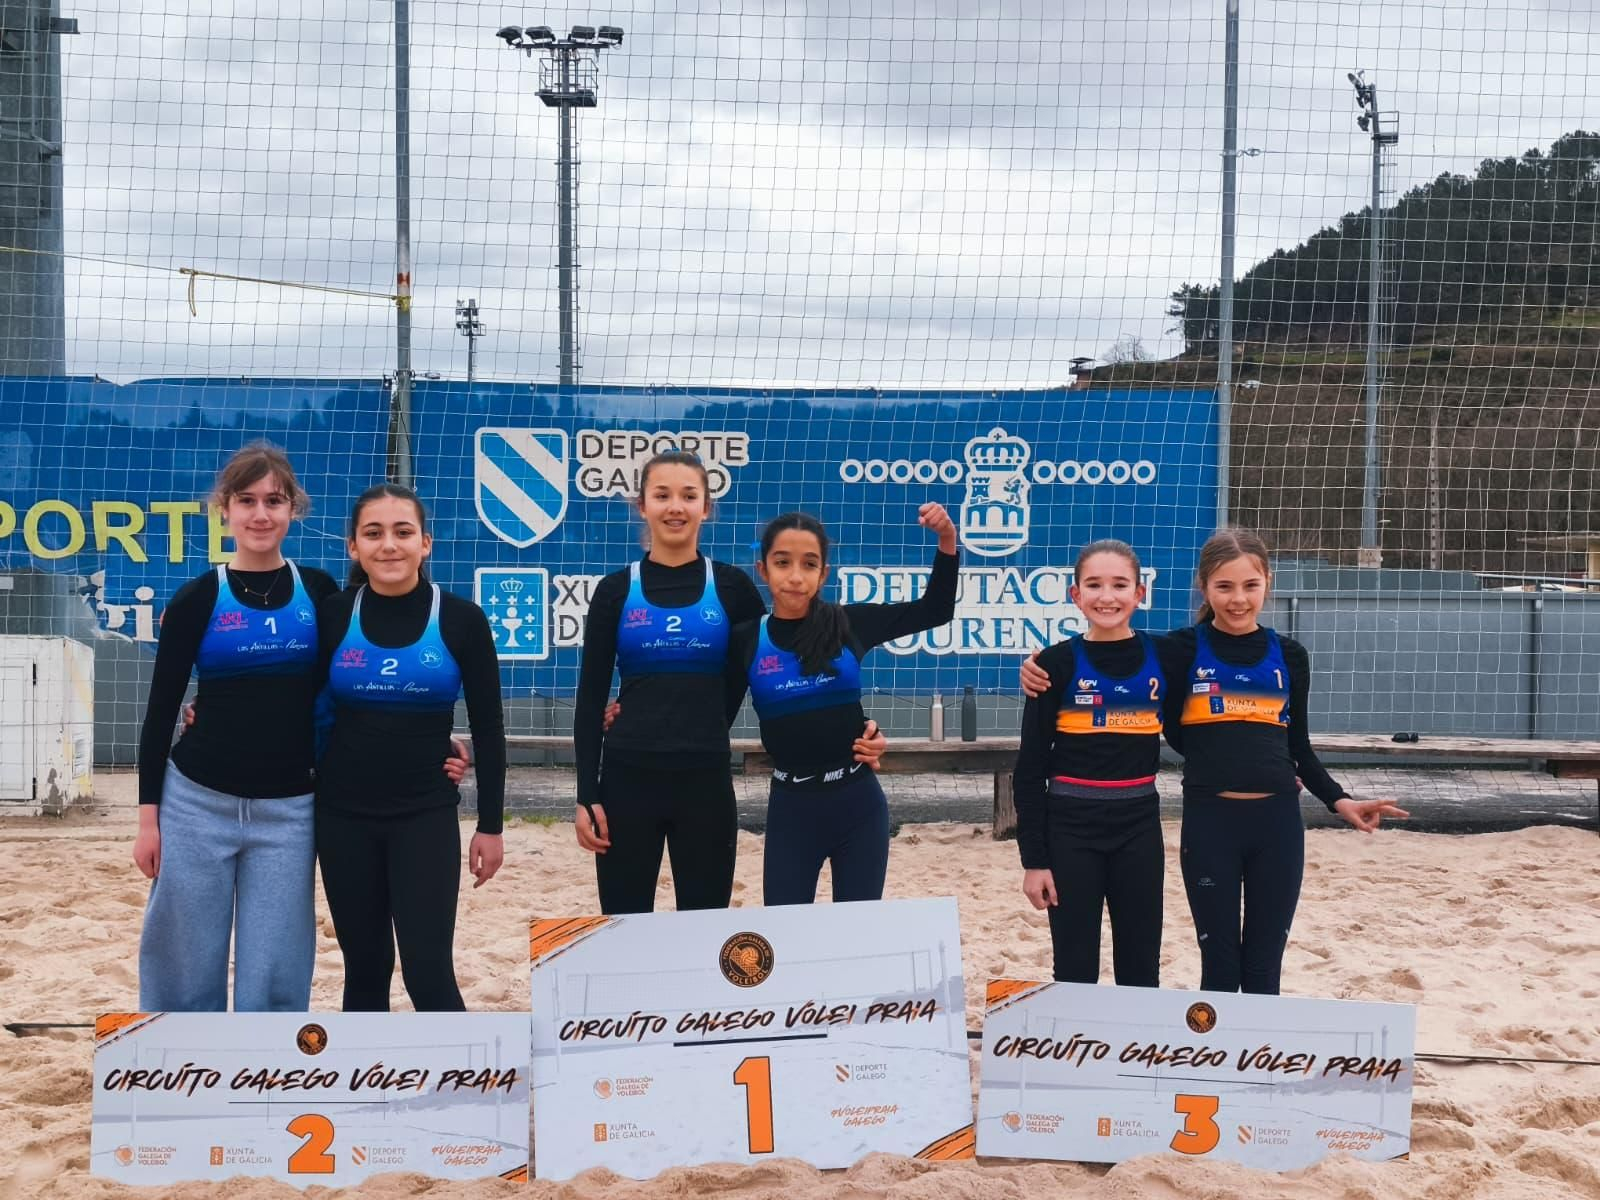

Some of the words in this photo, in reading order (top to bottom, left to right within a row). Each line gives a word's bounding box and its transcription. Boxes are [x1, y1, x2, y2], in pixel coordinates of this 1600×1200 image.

[581, 434, 745, 462] DEPORTE
[580, 467, 727, 494] GALO
[264, 616, 277, 635] 1
[666, 615, 682, 632] 2
[380, 658, 398, 676] 2
[1273, 668, 1283, 689] 1
[1148, 677, 1160, 700] 2
[824, 767, 845, 782] NIKE
[676, 1009, 777, 1035] GALEGO
[786, 1003, 858, 1029] VÓLEI
[865, 999, 939, 1024] PRAIA
[855, 1063, 888, 1072] DEPORTE
[1119, 1043, 1229, 1069] GALEGO
[1237, 1045, 1317, 1075] VÓLEI
[1323, 1057, 1405, 1083] PRAIA
[231, 1069, 341, 1094] GALEGO
[350, 1064, 431, 1093] VÓLEI
[437, 1068, 519, 1094] PRAIA
[855, 1072, 887, 1081] GALEGO
[734, 1056, 775, 1156] 1
[609, 1123, 638, 1131] XUNTA
[843, 1115, 887, 1127] GALEGO
[1113, 1120, 1143, 1128] XUNTA
[1170, 1094, 1222, 1157] 3
[609, 1132, 621, 1140] DE
[622, 1130, 656, 1139] GALICIA
[1113, 1129, 1125, 1137] DE
[1126, 1129, 1160, 1138] GALICIA
[1258, 1127, 1292, 1137] DEPORTE
[287, 1113, 336, 1175] 2
[1258, 1137, 1289, 1146] GALEGO
[1327, 1139, 1371, 1150] GALEGO
[226, 1147, 255, 1155] XUNTA
[372, 1147, 407, 1155] DEPORTE
[226, 1156, 237, 1164] DE
[239, 1156, 273, 1164] GALICIA
[372, 1156, 404, 1165] GALEGO
[443, 1155, 488, 1166] GALEGO
